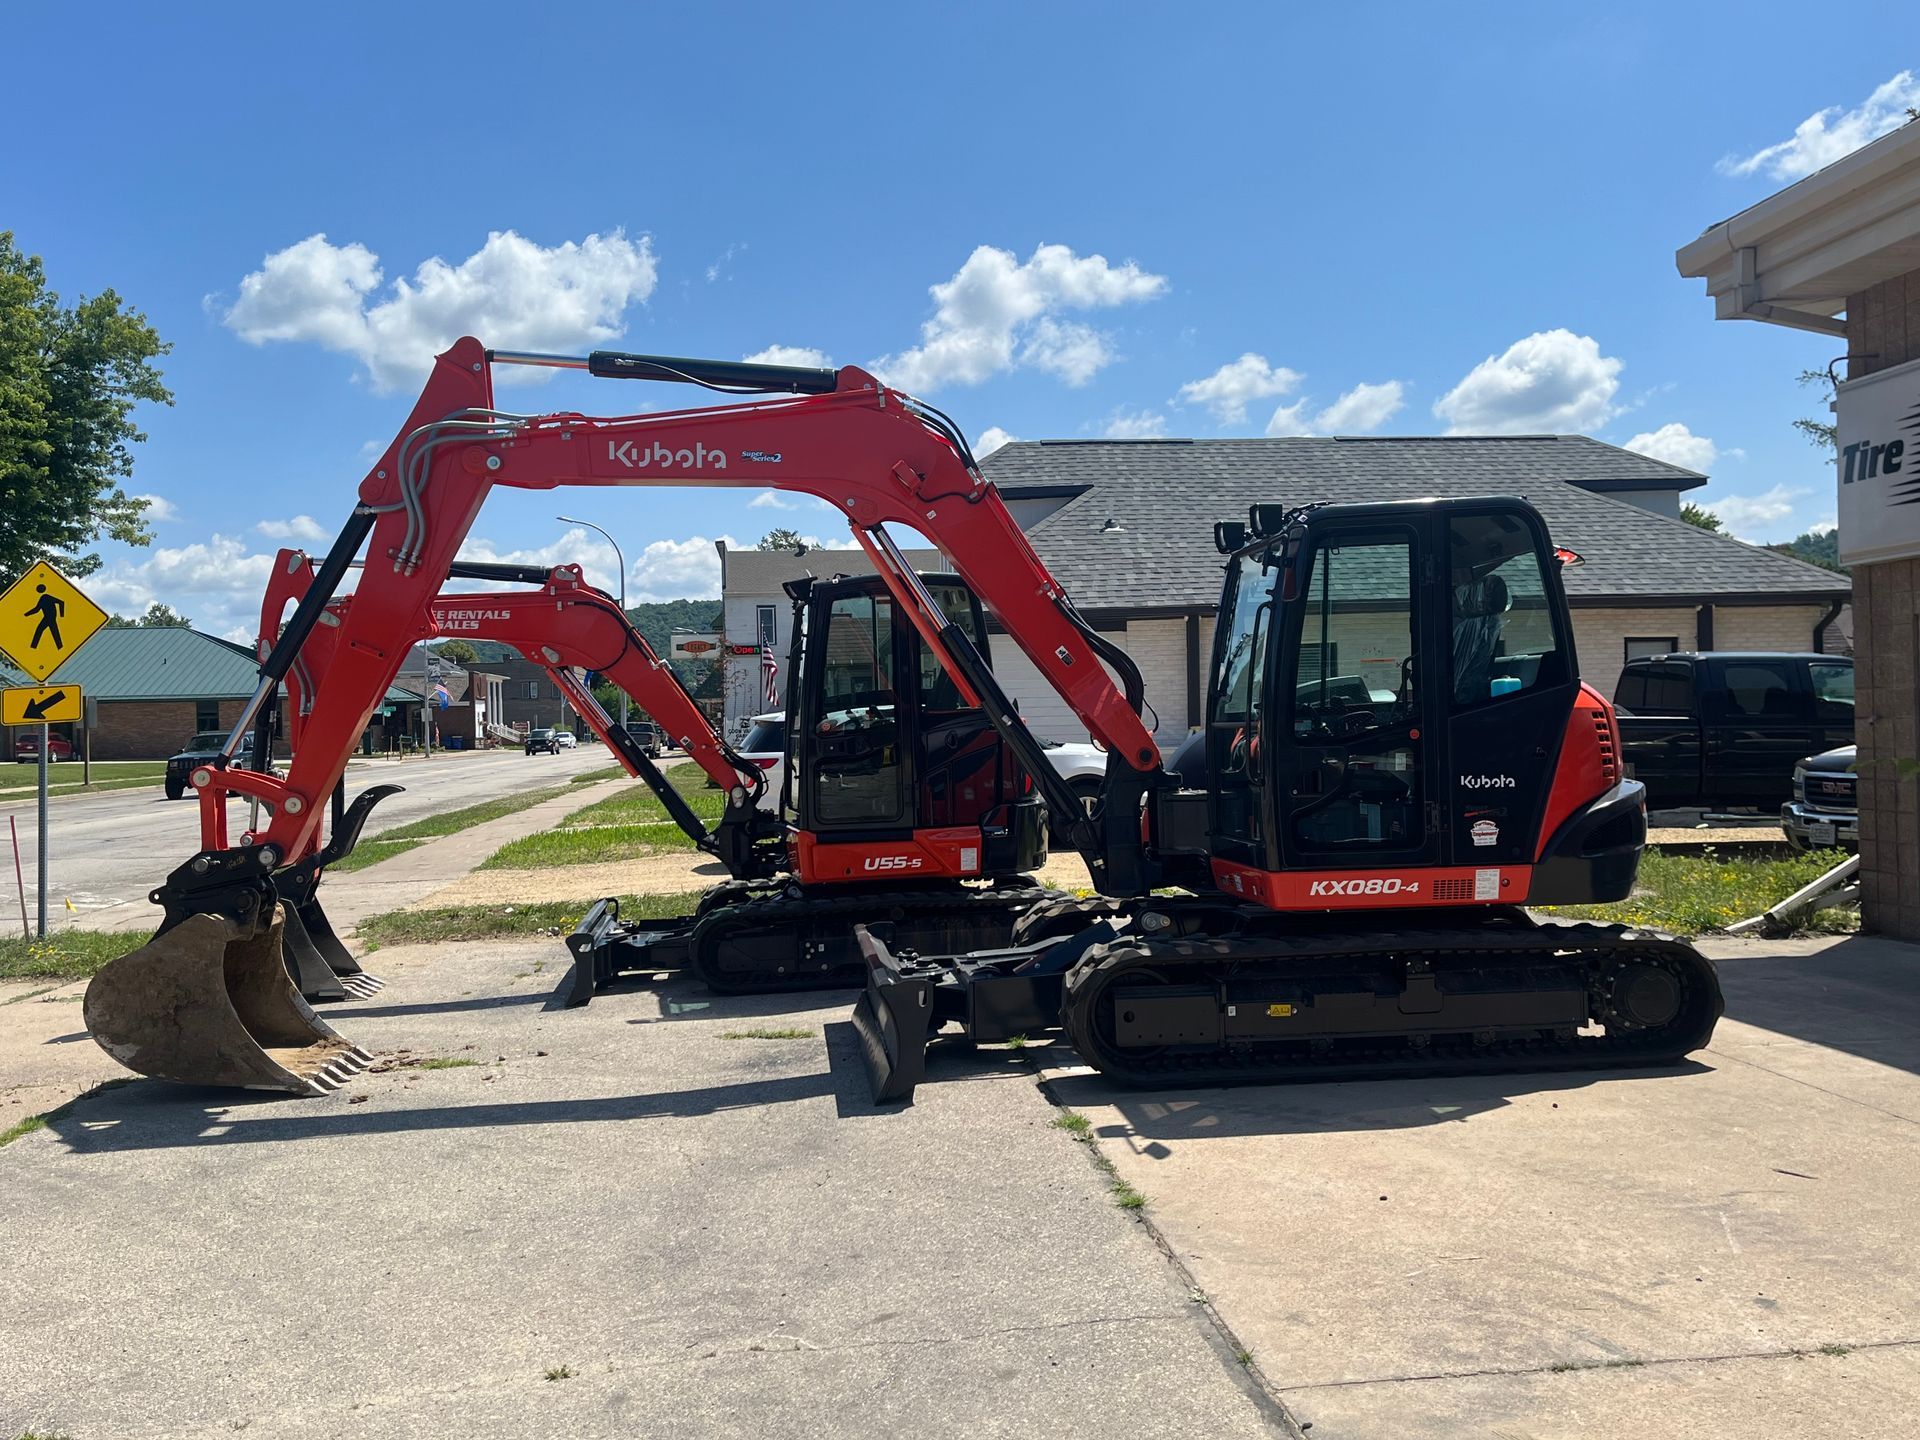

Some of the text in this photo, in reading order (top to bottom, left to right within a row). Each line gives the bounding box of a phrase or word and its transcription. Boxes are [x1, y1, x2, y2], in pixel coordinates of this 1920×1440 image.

[608, 440, 727, 468] Kubota
[741, 450, 764, 458] Super
[1842, 439, 1905, 485] Tire
[447, 610, 511, 620] RENTALS
[438, 620, 480, 630] SALES
[733, 645, 760, 654] Open
[1460, 774, 1516, 789] Kubota
[1822, 781, 1852, 795] GMC
[864, 855, 922, 871] U55-5
[1309, 878, 1420, 897] KX080-4
